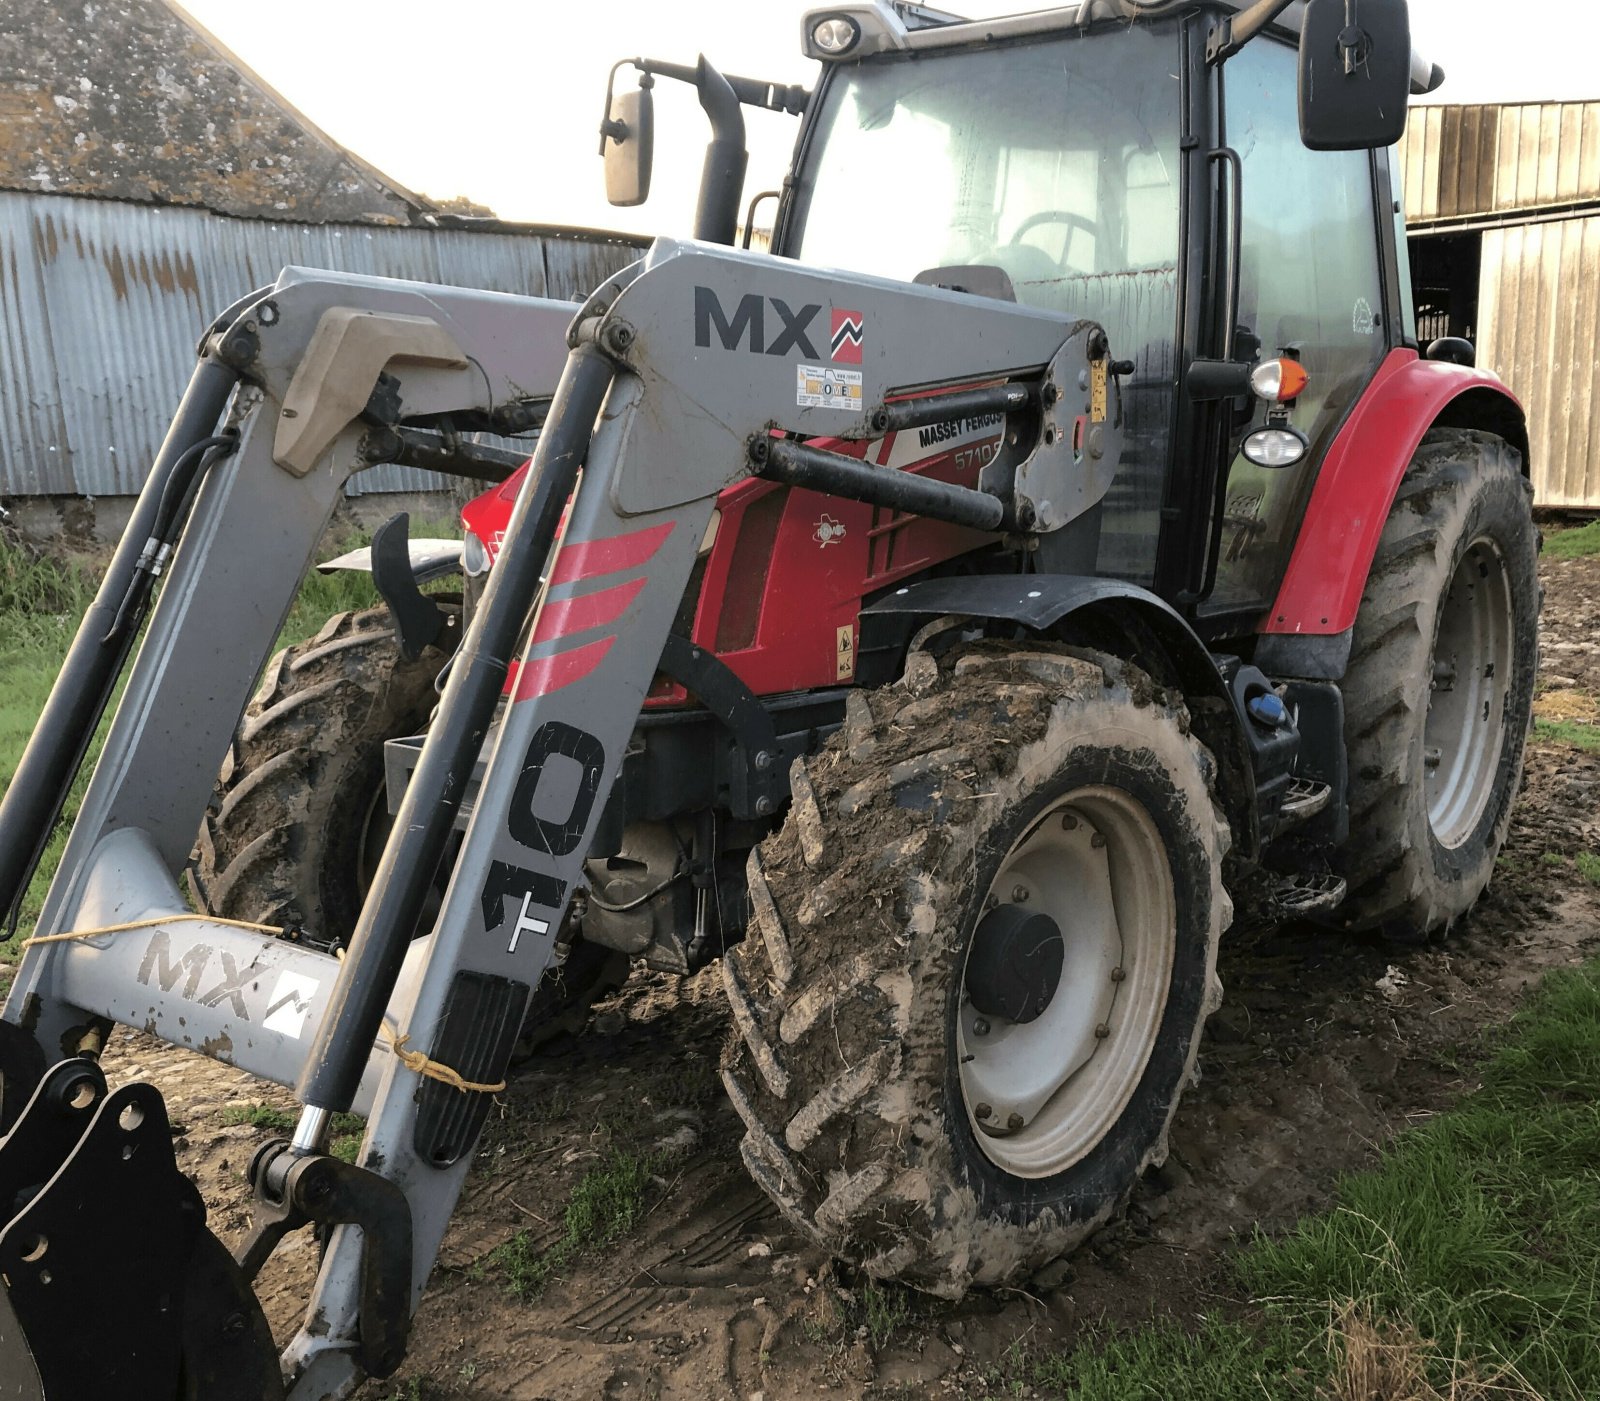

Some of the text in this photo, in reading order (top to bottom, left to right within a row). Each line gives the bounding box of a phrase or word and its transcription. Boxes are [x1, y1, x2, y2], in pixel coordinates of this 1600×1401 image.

[694, 286, 822, 360] MX
[919, 419, 965, 448] MASSEY
[955, 444, 992, 470] 5710
[136, 929, 271, 1022] MX
